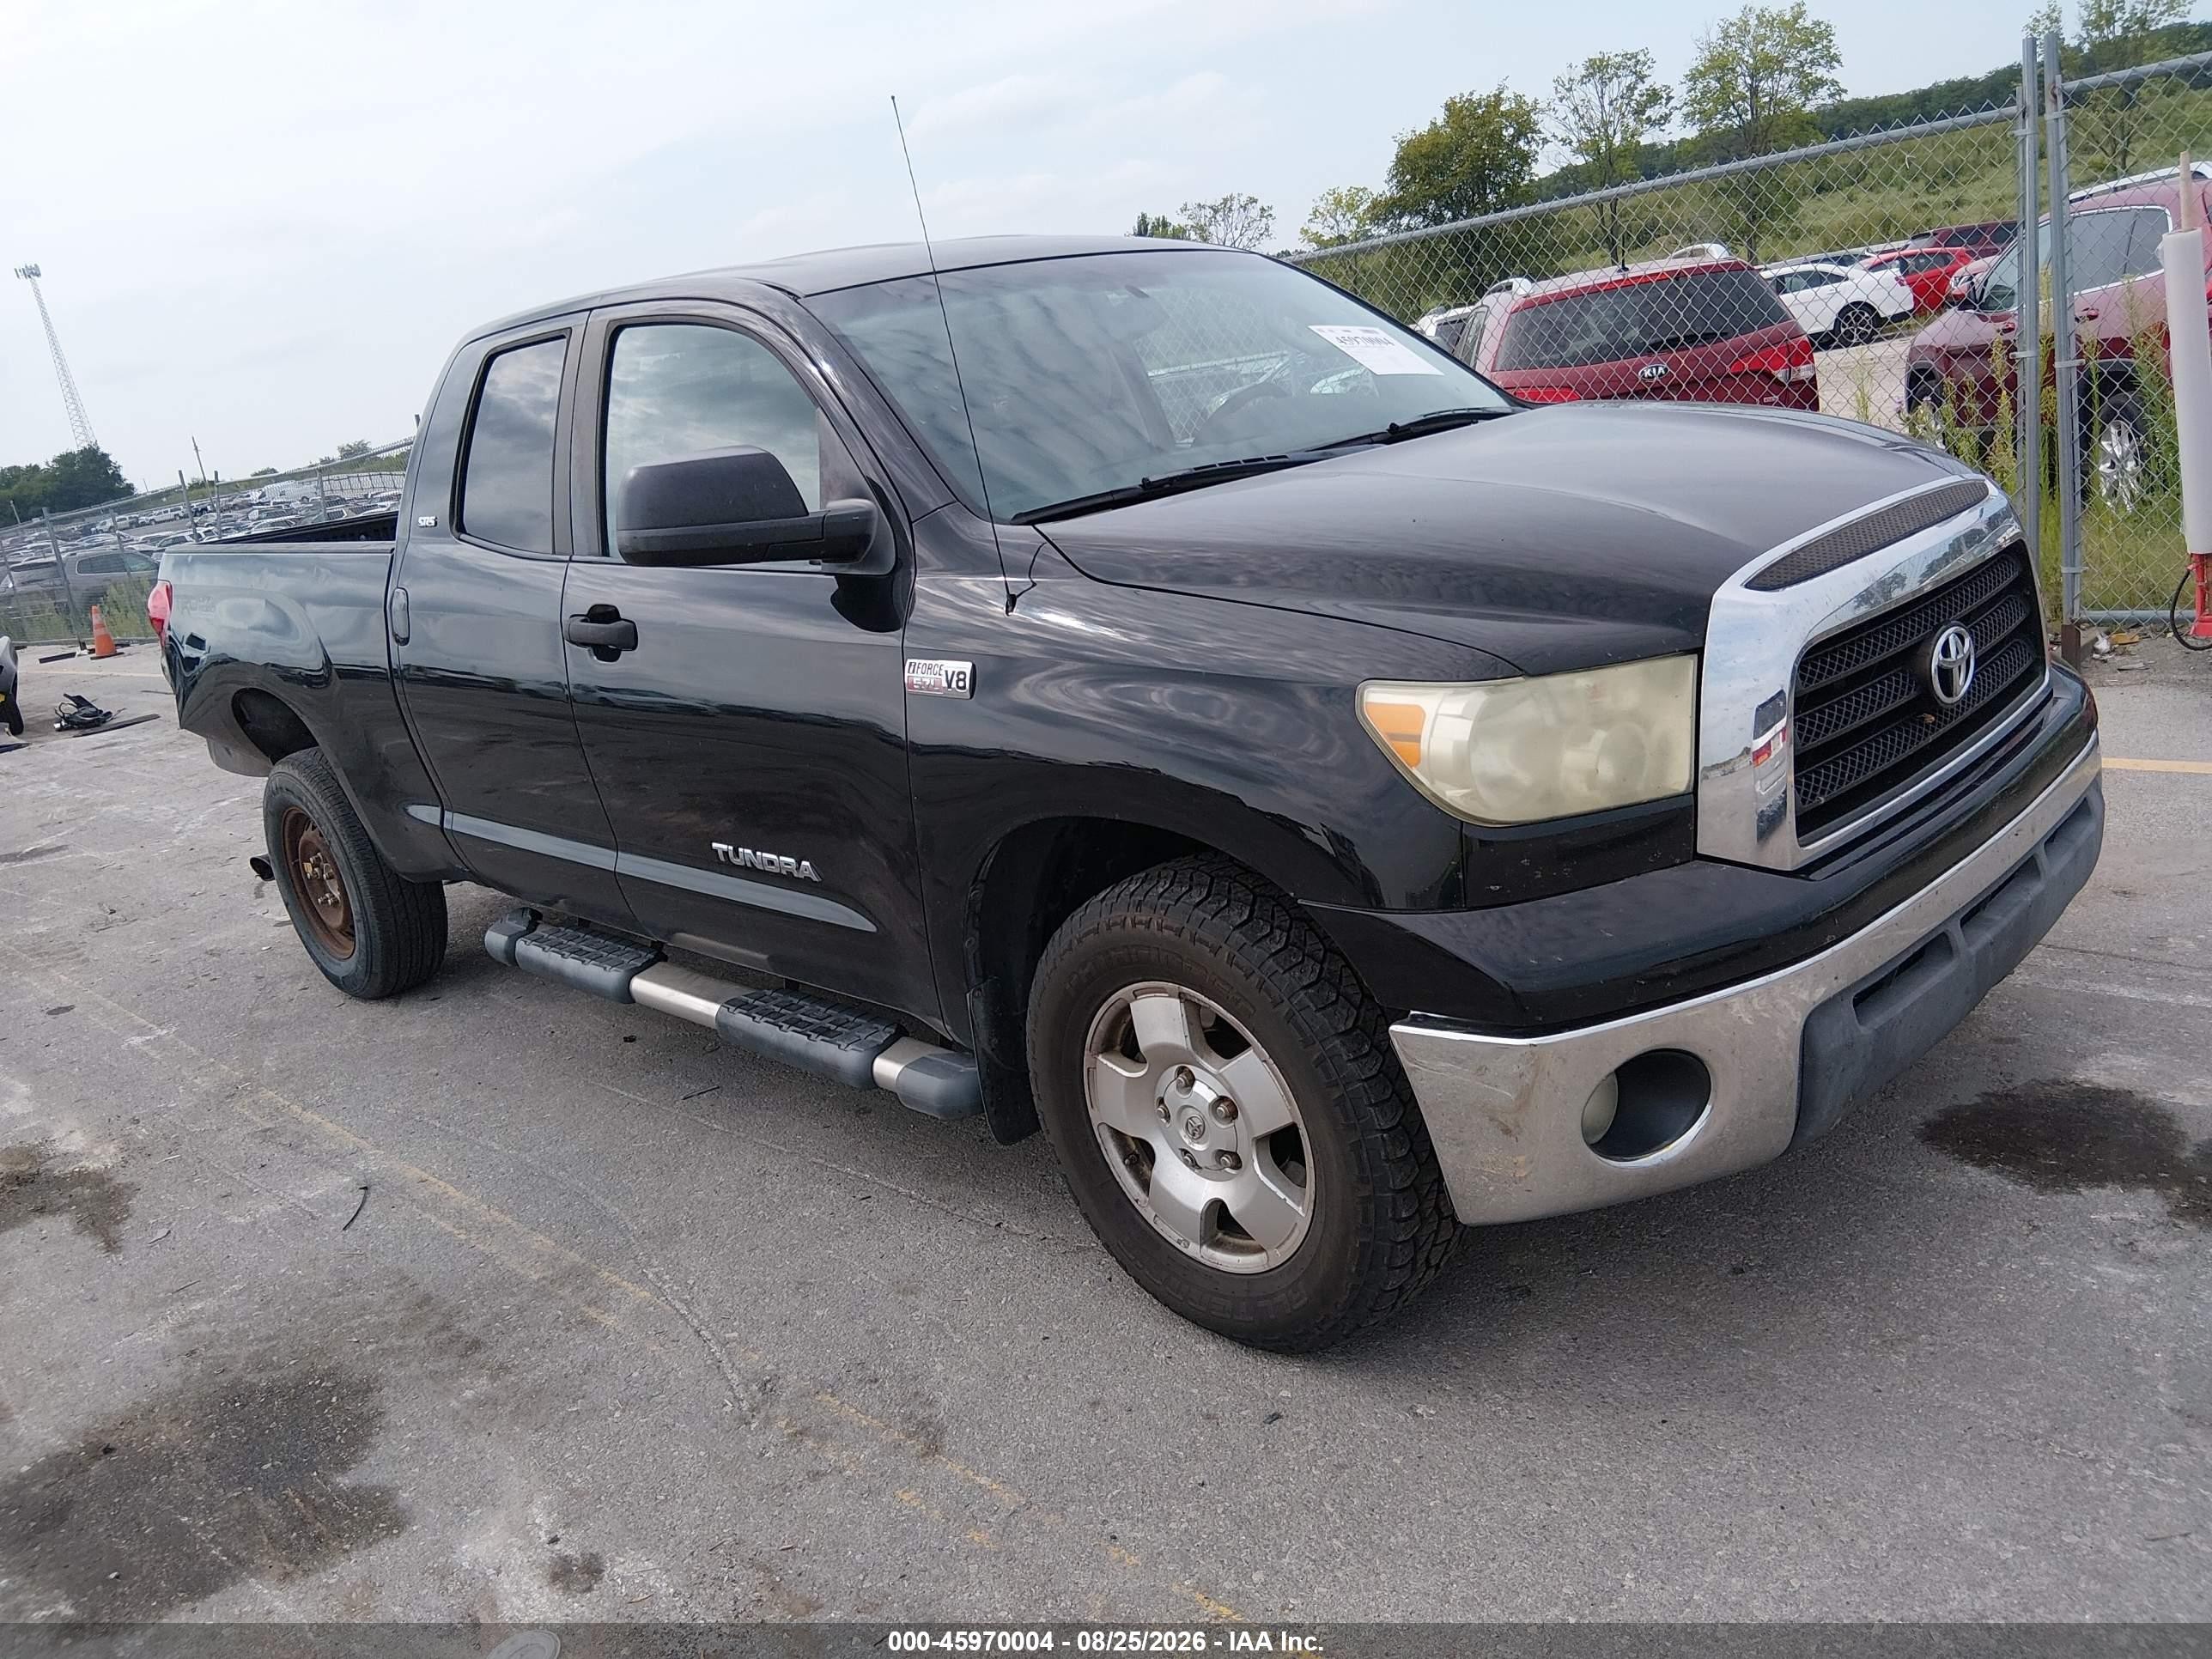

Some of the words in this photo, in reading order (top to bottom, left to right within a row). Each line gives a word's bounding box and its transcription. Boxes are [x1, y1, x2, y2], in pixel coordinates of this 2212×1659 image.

[1644, 367, 1666, 378] KIA
[945, 670, 967, 690] V8
[711, 842, 822, 883] TUNDRA
